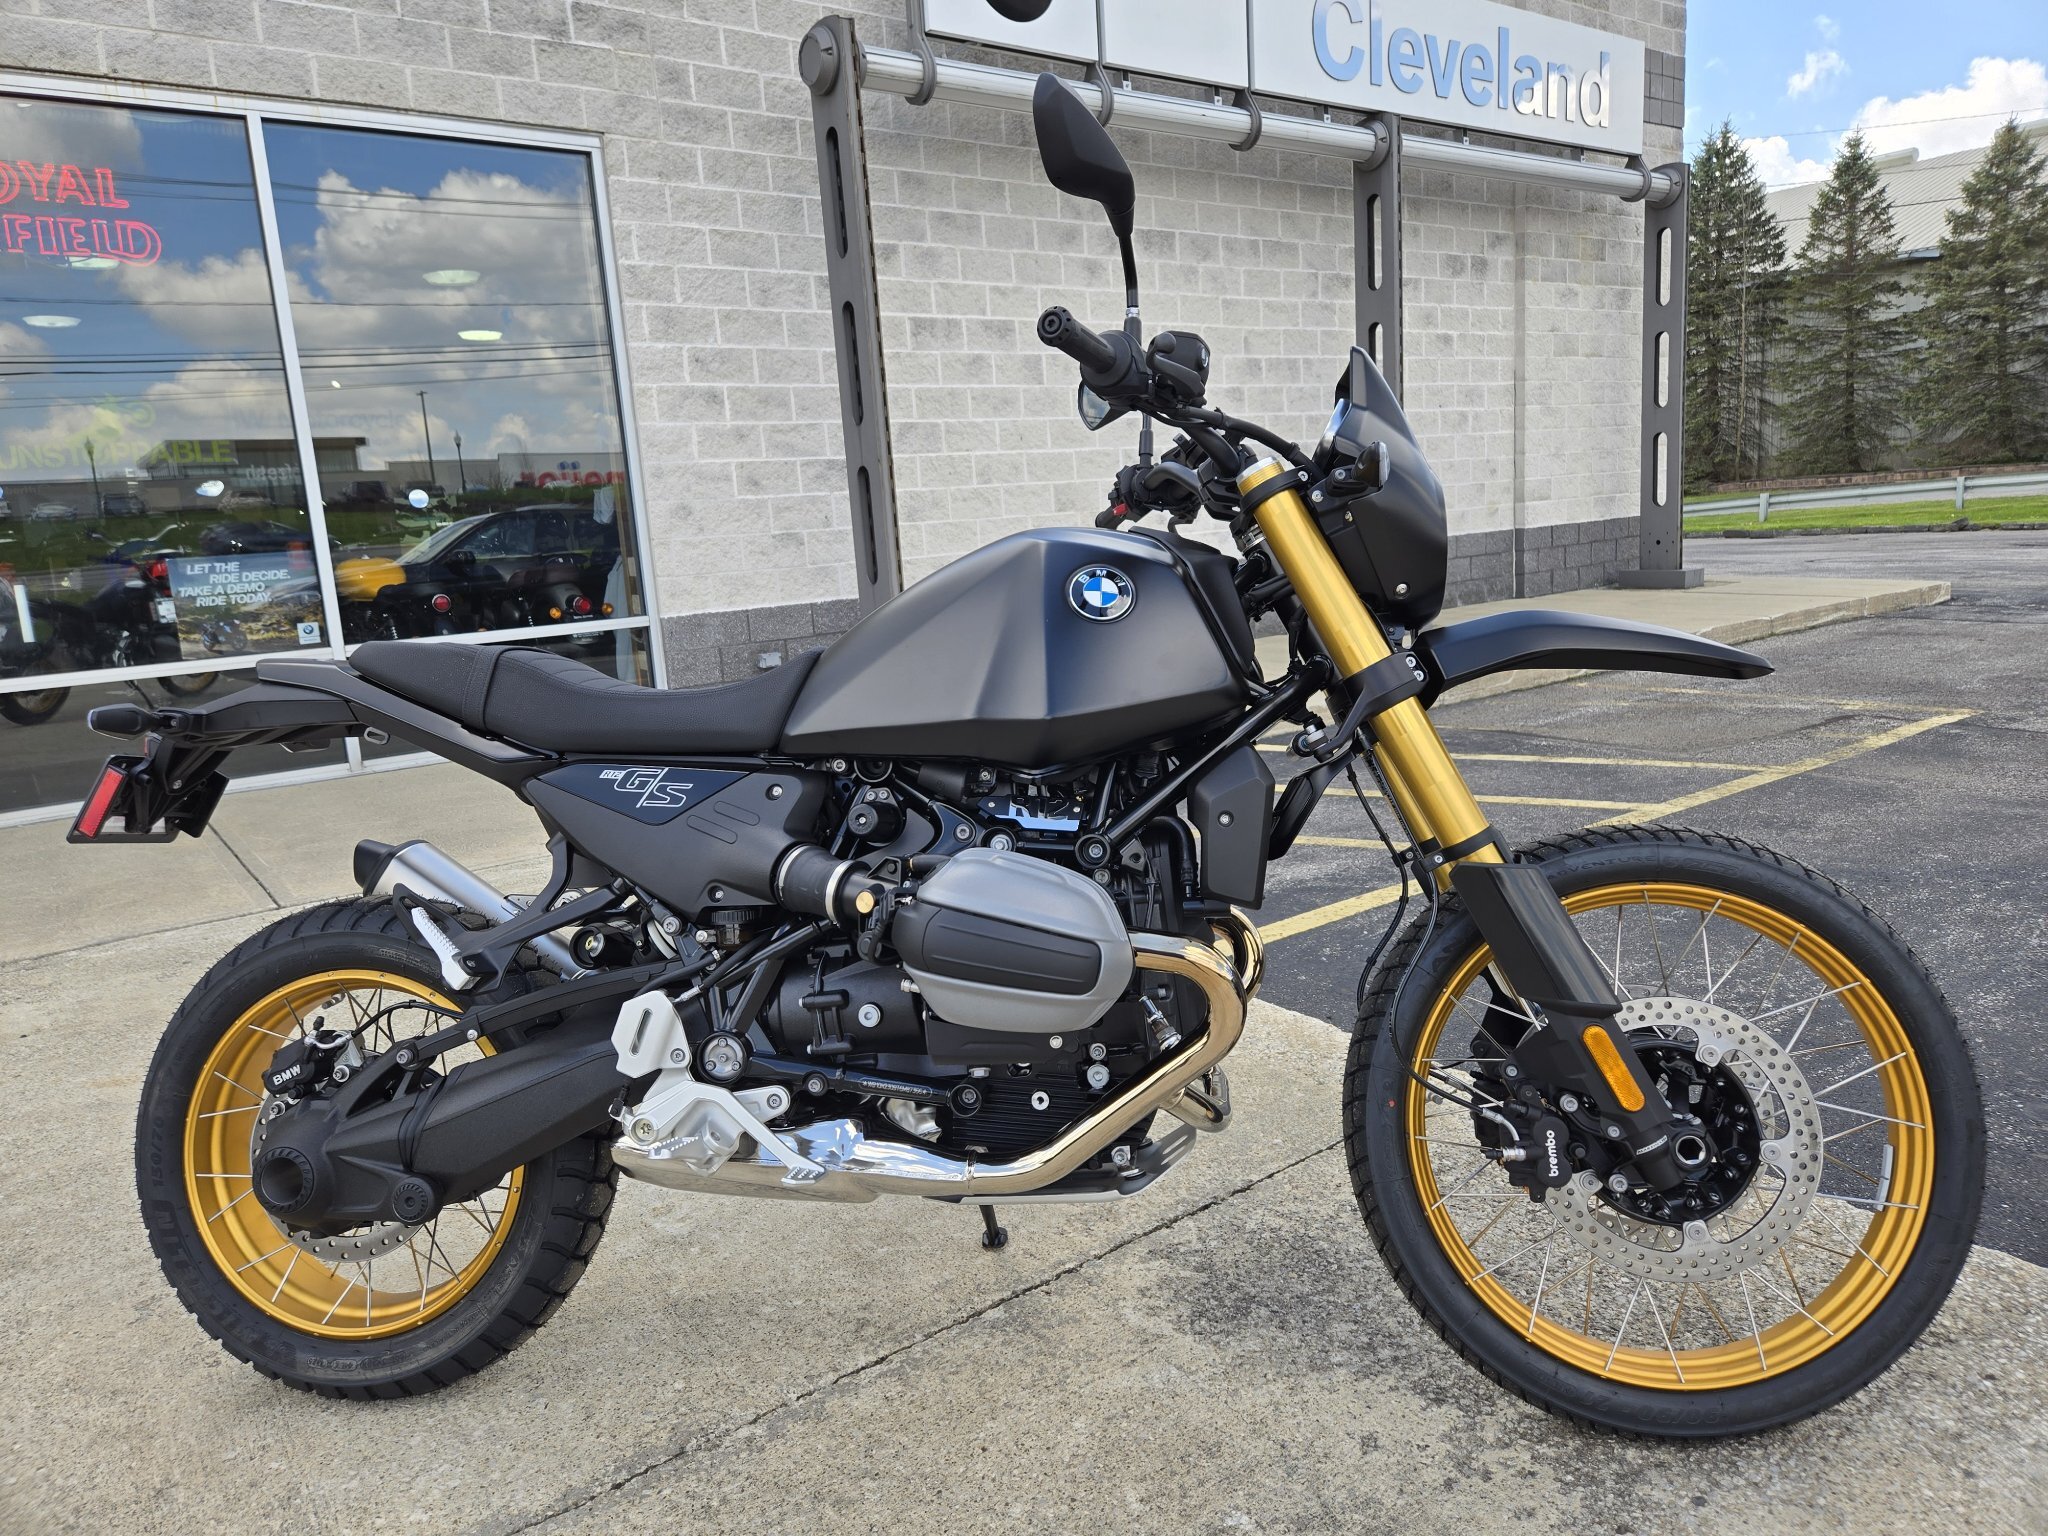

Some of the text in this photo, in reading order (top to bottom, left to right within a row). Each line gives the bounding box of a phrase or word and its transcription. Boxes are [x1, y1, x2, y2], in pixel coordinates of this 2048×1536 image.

[1312, 0, 1610, 128] Cleveland
[186, 562, 240, 575] LET THE
[210, 570, 291, 584] RIDE DECIDE.
[1078, 570, 1126, 586] BMW
[179, 583, 265, 598] TAKE A DEMO
[196, 592, 272, 607] RIDE TODAY.
[272, 1064, 301, 1086] BMW
[1545, 1129, 1559, 1177] brembo
